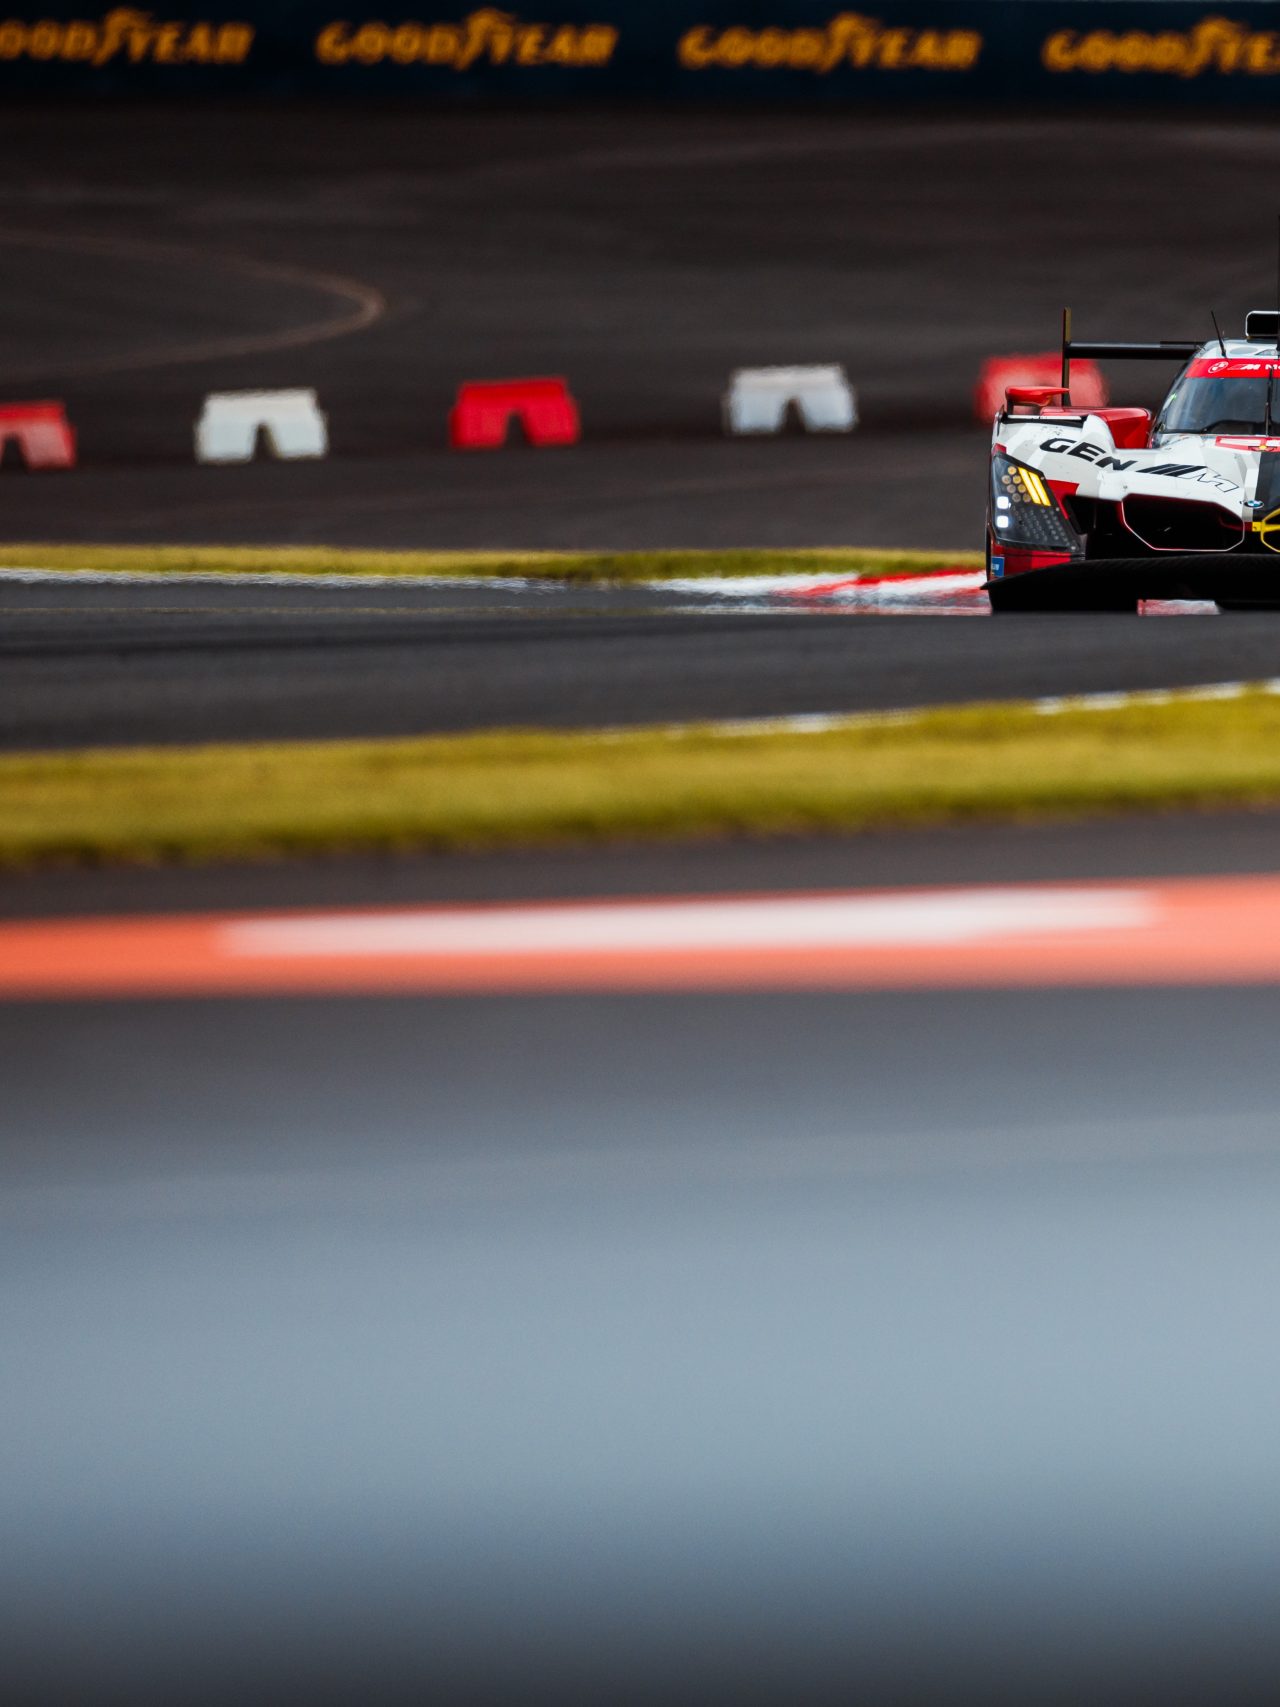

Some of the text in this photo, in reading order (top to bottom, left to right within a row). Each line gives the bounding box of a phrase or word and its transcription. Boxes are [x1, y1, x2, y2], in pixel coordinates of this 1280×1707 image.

[315, 9, 618, 69] GOODYEAR
[679, 12, 982, 71] GOODYEAR
[1039, 437, 1138, 471] GEN
